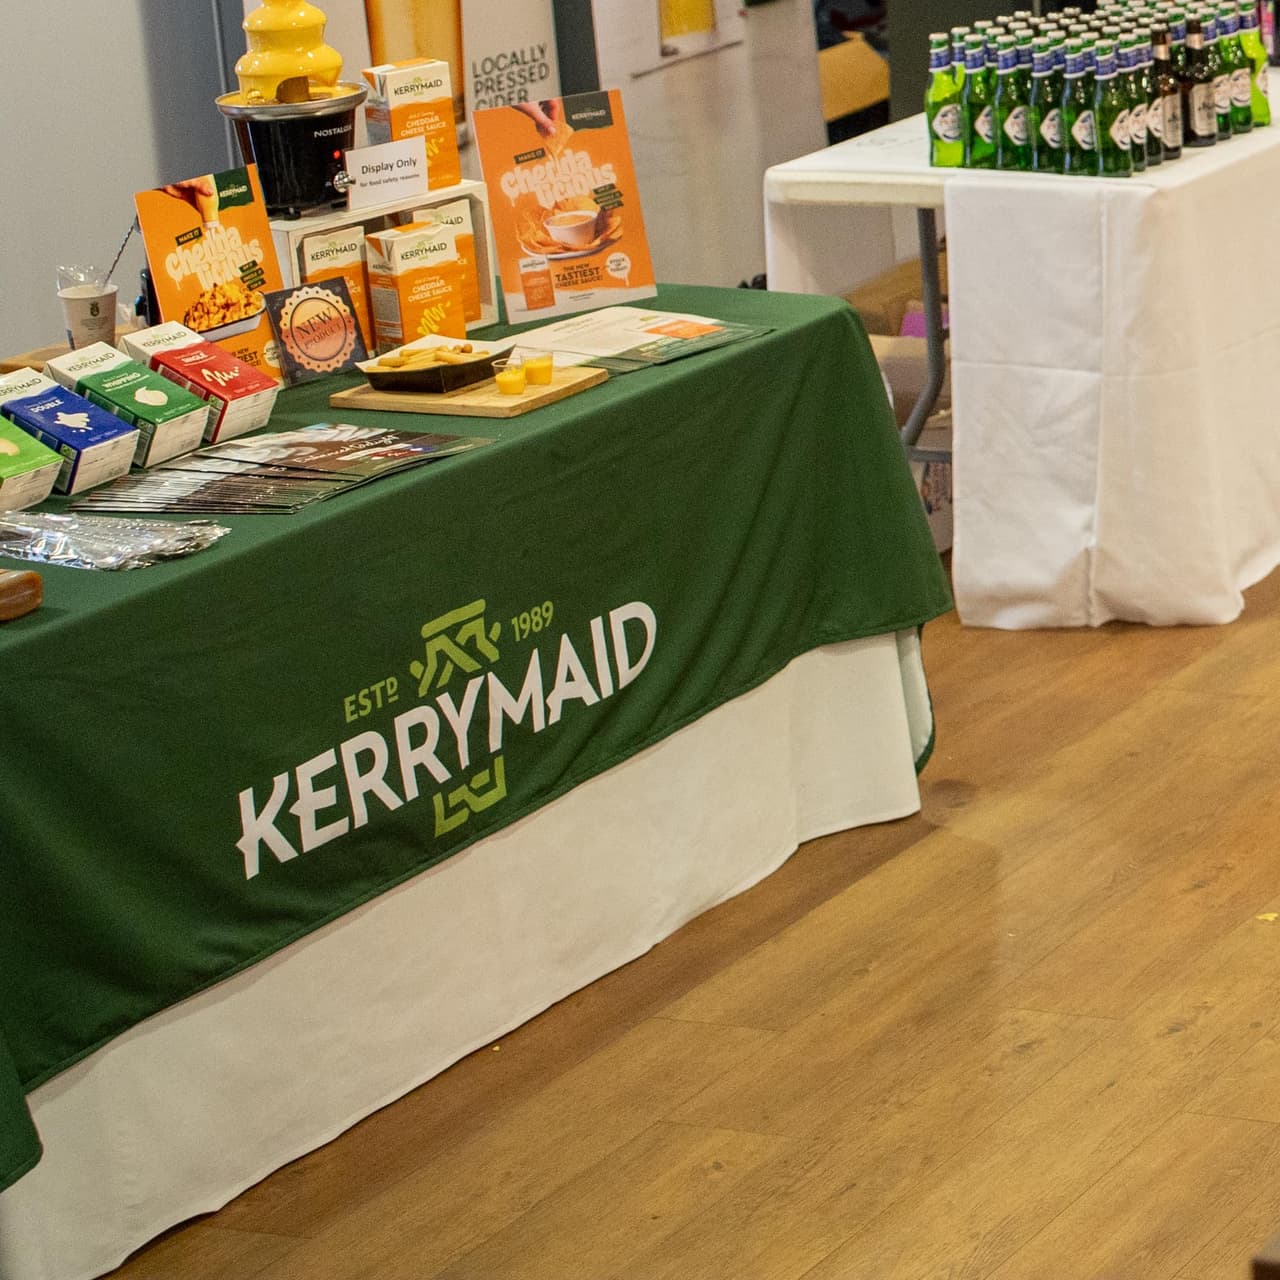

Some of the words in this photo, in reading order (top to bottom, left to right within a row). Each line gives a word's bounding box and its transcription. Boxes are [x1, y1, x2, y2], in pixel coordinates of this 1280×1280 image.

[472, 43, 548, 79] LOCALLY
[394, 79, 443, 96] KERRYMAID
[474, 63, 550, 97] PRESSED
[361, 162, 394, 175] Display
[396, 157, 417, 168] Only
[311, 243, 357, 261] KERRYMAID
[401, 243, 447, 261] KERRYMAID
[555, 267, 600, 282] TASTIEST
[296, 307, 333, 339] NEW
[142, 331, 187, 348] KERRYMAID
[66, 352, 115, 371] KERRYMAID
[511, 600, 554, 643] 1989
[235, 601, 657, 881] KERRYMAID
